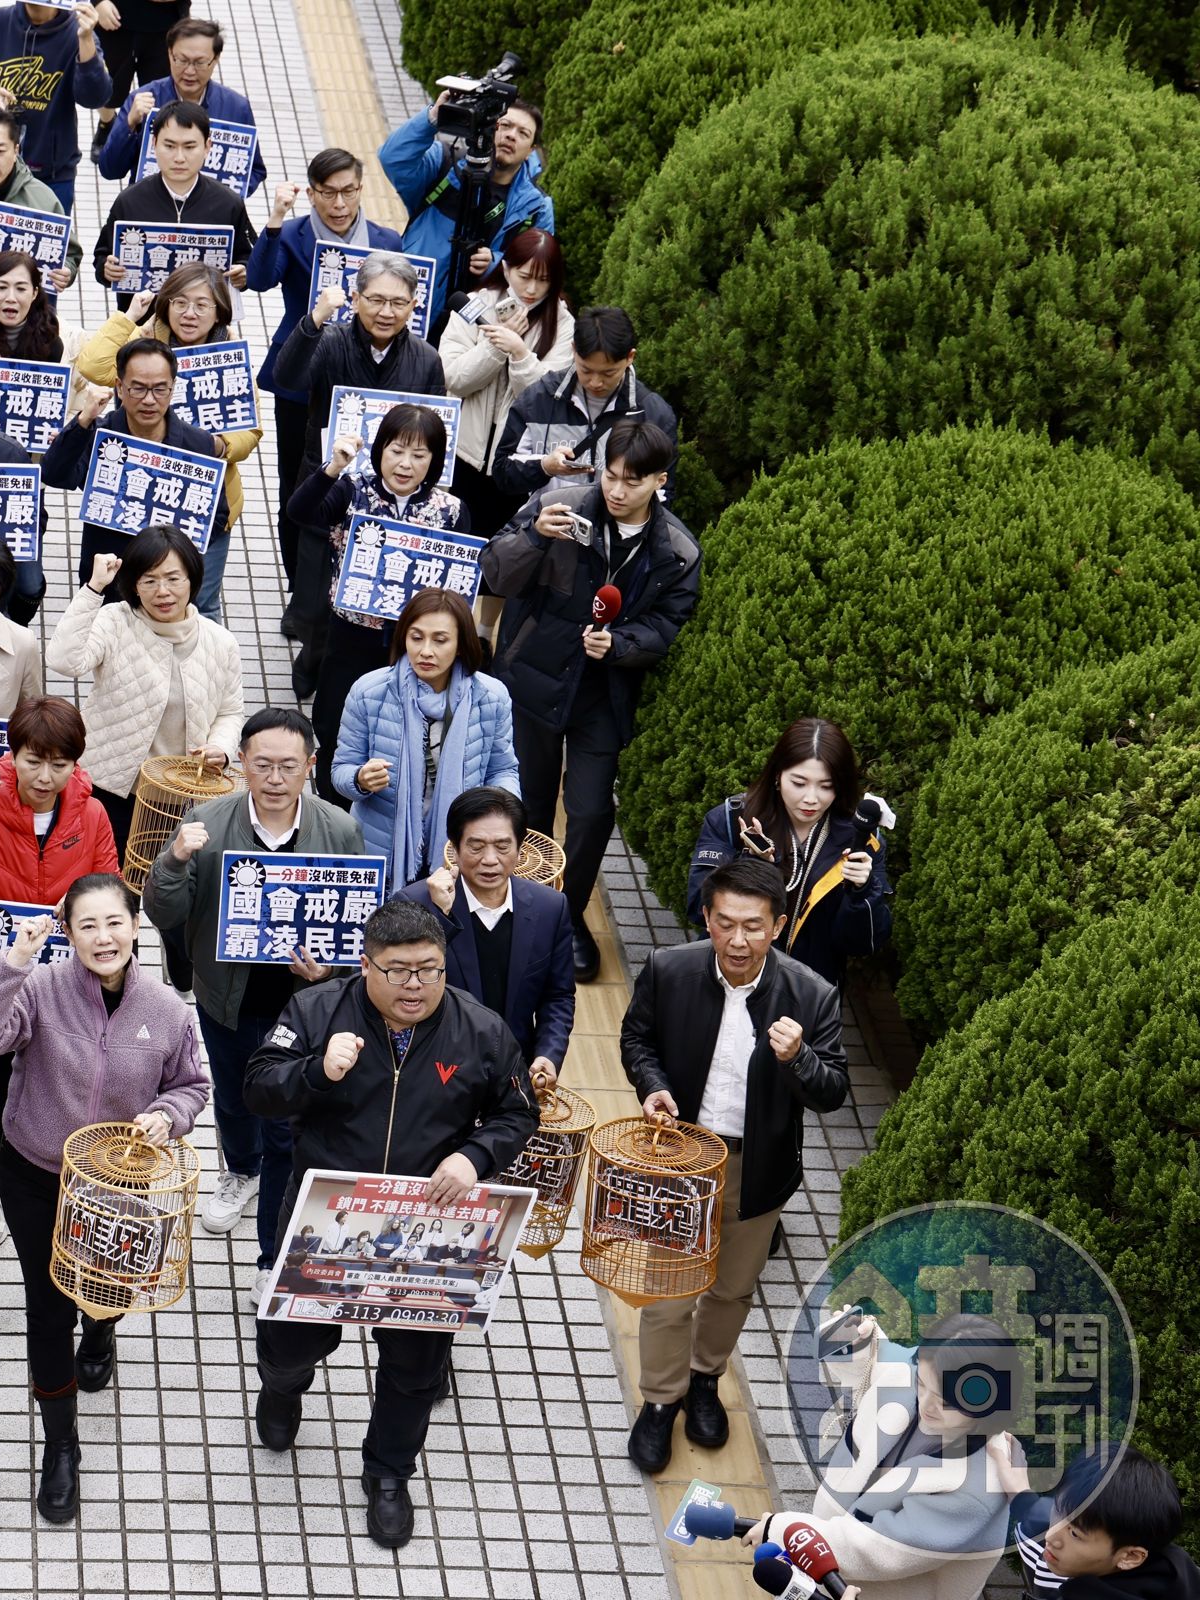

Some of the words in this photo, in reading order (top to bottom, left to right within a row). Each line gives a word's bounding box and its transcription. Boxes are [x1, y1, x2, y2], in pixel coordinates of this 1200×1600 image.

[267, 869, 377, 885] 一分鐘沒收罷免權
[335, 1196, 366, 1212] 鎖門
